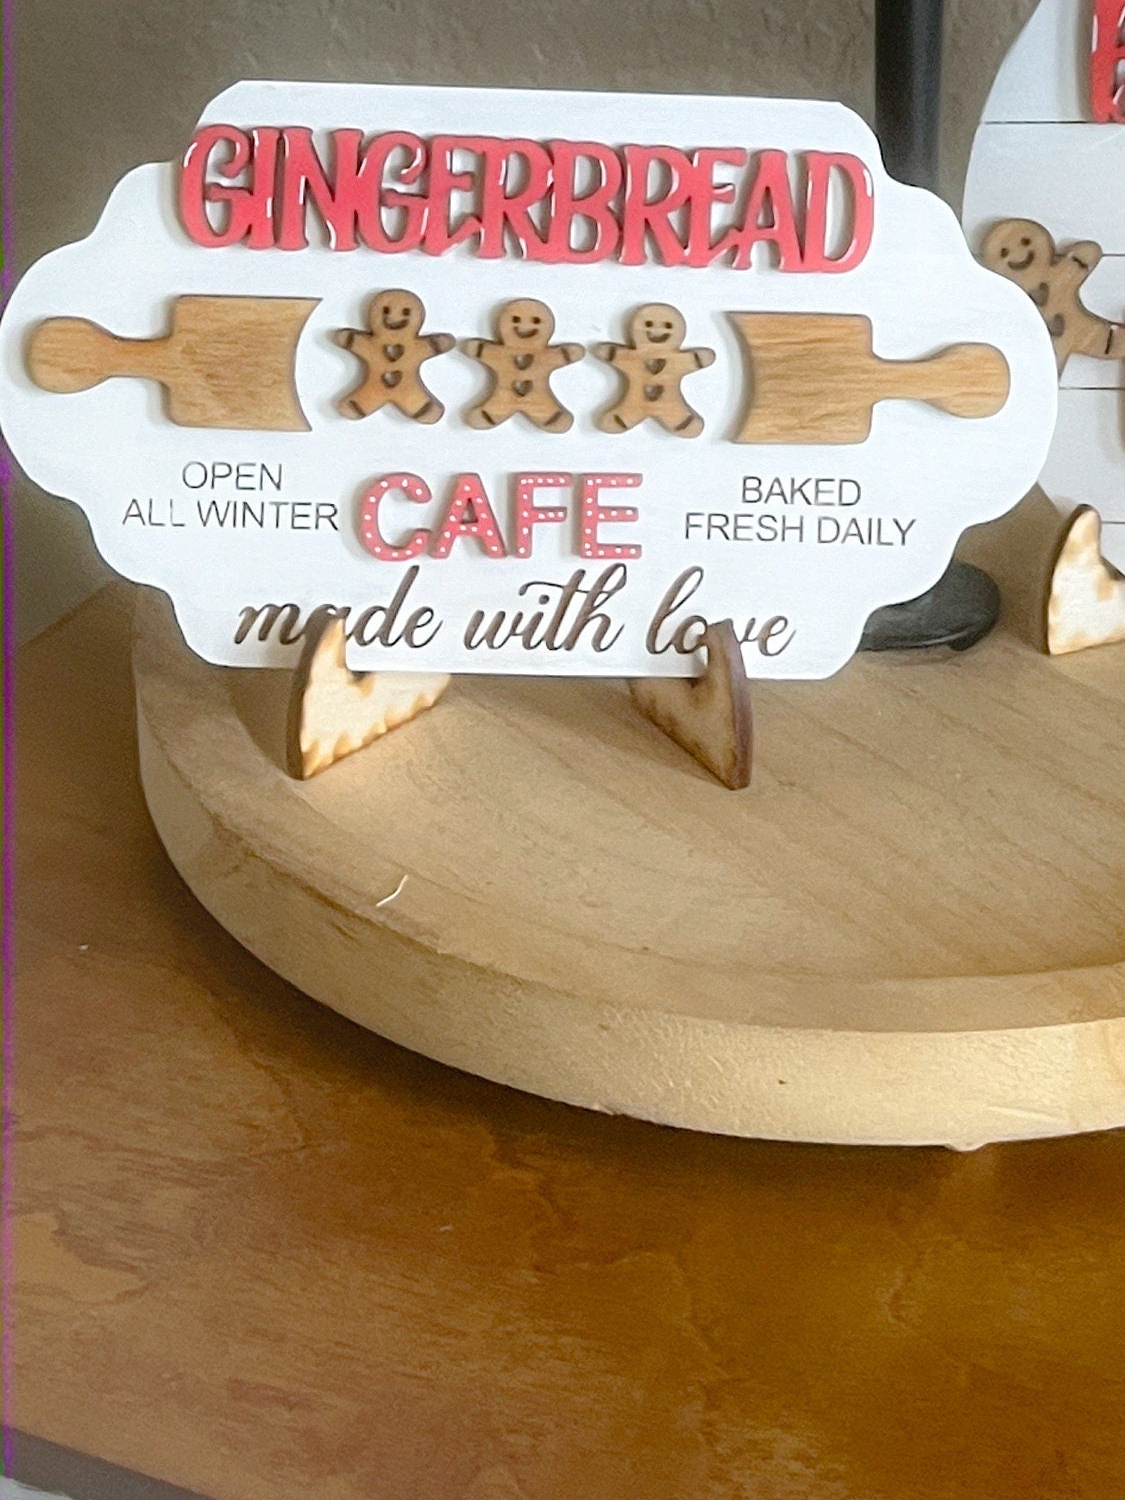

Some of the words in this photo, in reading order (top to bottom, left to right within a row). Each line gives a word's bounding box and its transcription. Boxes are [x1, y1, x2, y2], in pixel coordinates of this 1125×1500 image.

[181, 125, 874, 272] GINGERBREAD
[181, 461, 284, 494] OPEN
[741, 475, 862, 507] BAKED
[122, 500, 186, 528] ALL
[194, 500, 339, 532] WINTER
[358, 473, 643, 561] CAFE
[684, 512, 811, 543] FRESH
[817, 514, 917, 547] DAILY
[464, 562, 628, 654] with
